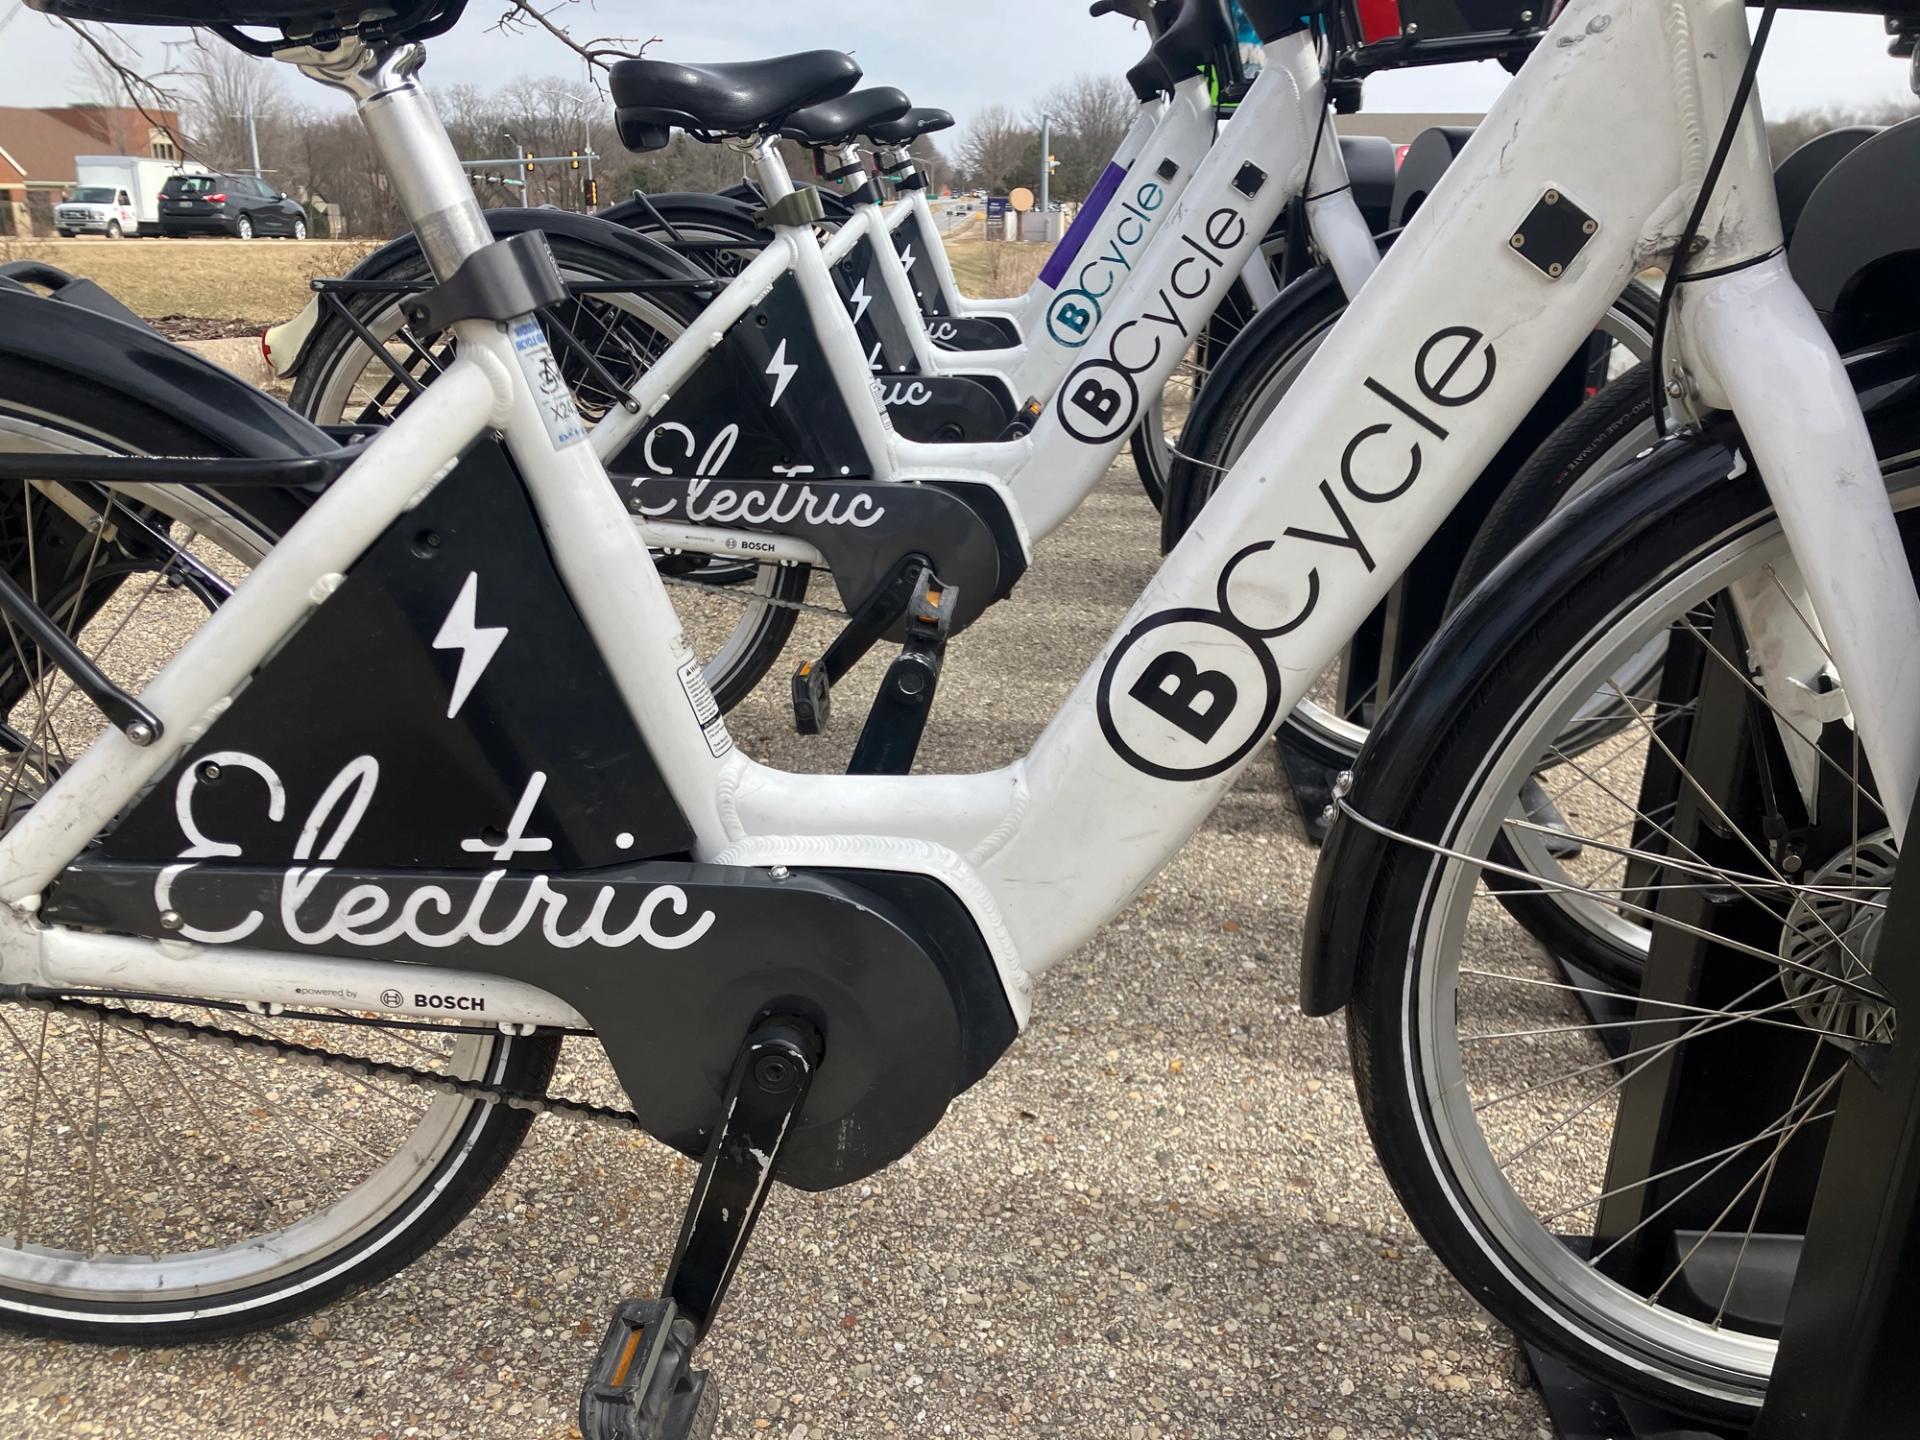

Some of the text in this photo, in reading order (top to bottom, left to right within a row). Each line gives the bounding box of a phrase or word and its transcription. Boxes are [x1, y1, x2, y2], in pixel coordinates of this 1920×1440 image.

[1070, 207, 1246, 427] BCycle
[1606, 398, 1652, 436] ARD-CASE
[630, 421, 886, 528] Electric
[741, 540, 776, 552] BOSCH
[1127, 325, 1497, 745] BCycle
[154, 751, 717, 951] Electric
[413, 993, 486, 1012] BOSCH
